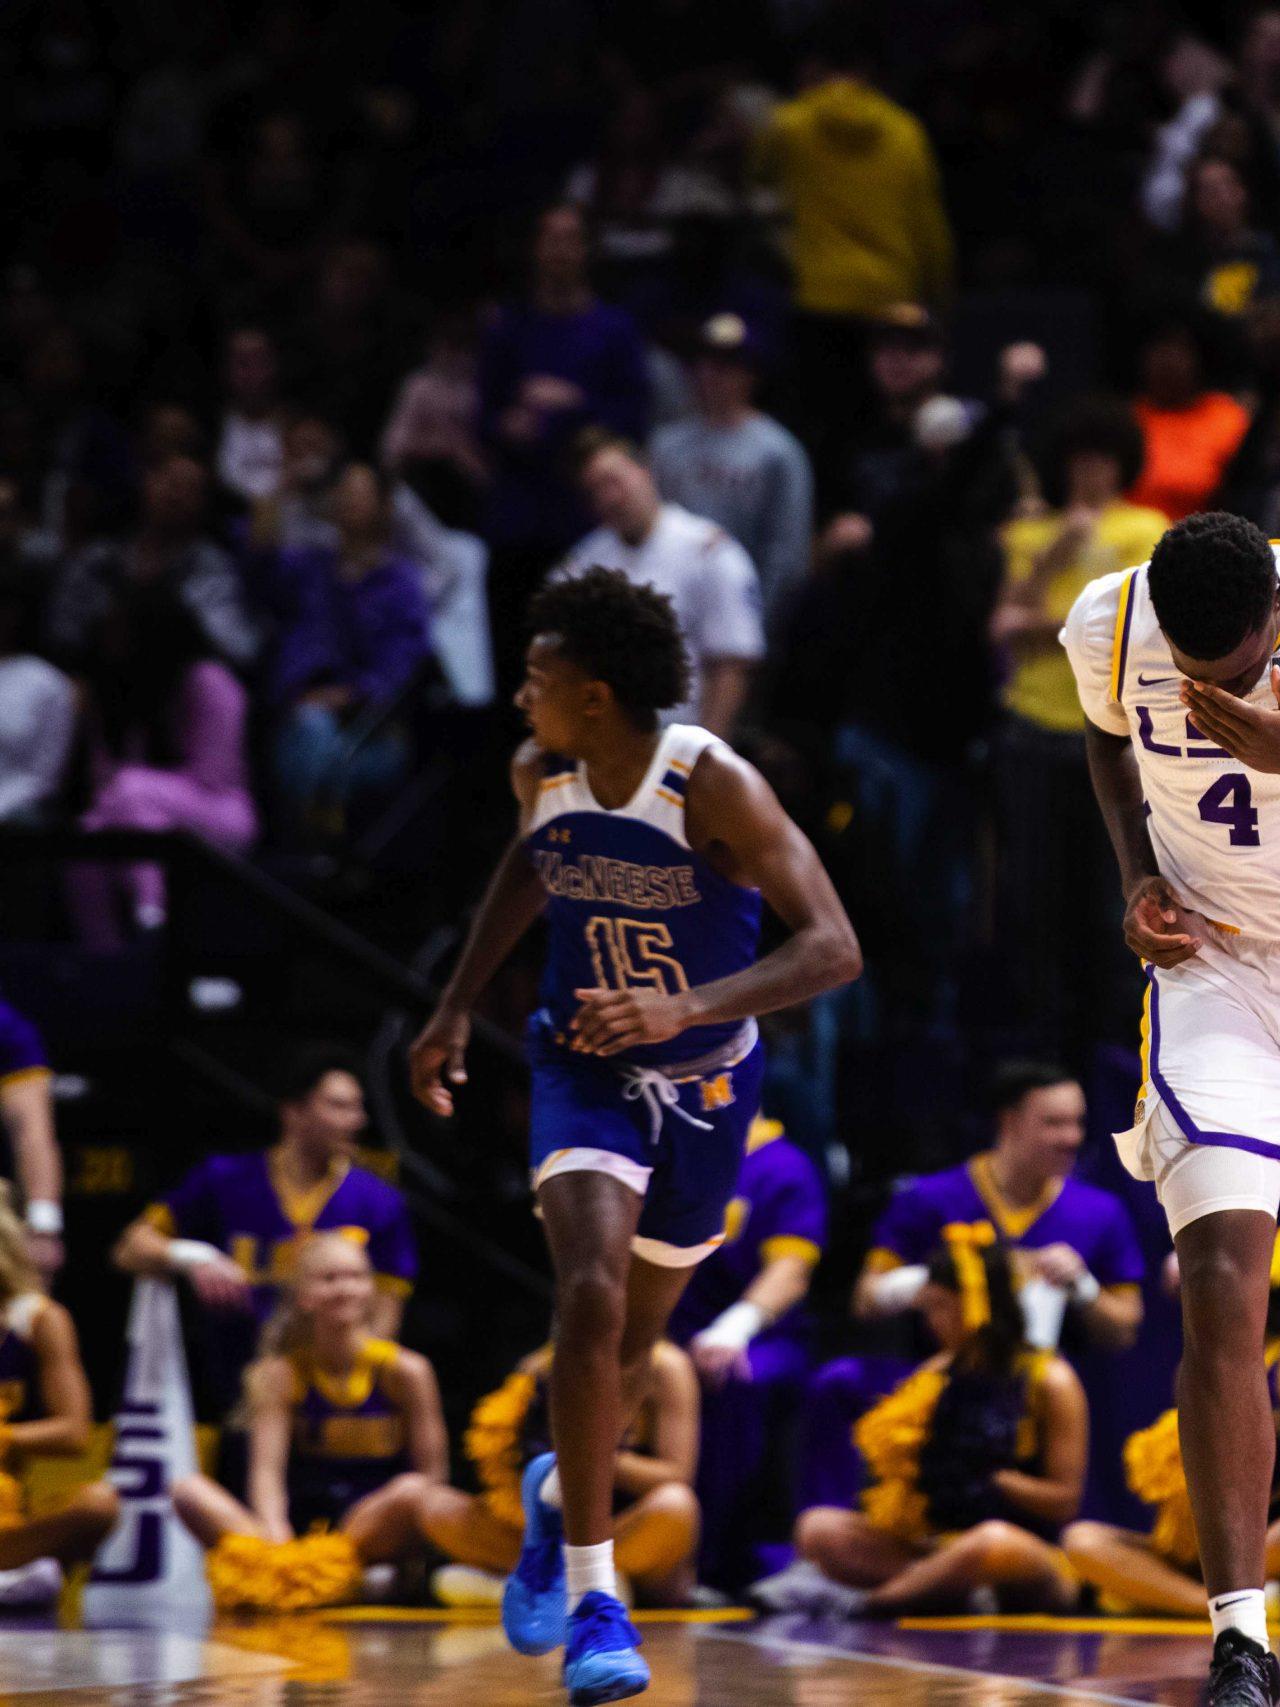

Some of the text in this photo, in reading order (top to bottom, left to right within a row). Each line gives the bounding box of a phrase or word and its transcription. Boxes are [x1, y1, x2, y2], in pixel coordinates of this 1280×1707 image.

[1197, 773, 1261, 847] 4
[535, 849, 702, 911] McNEESE
[585, 915, 691, 996] 15
